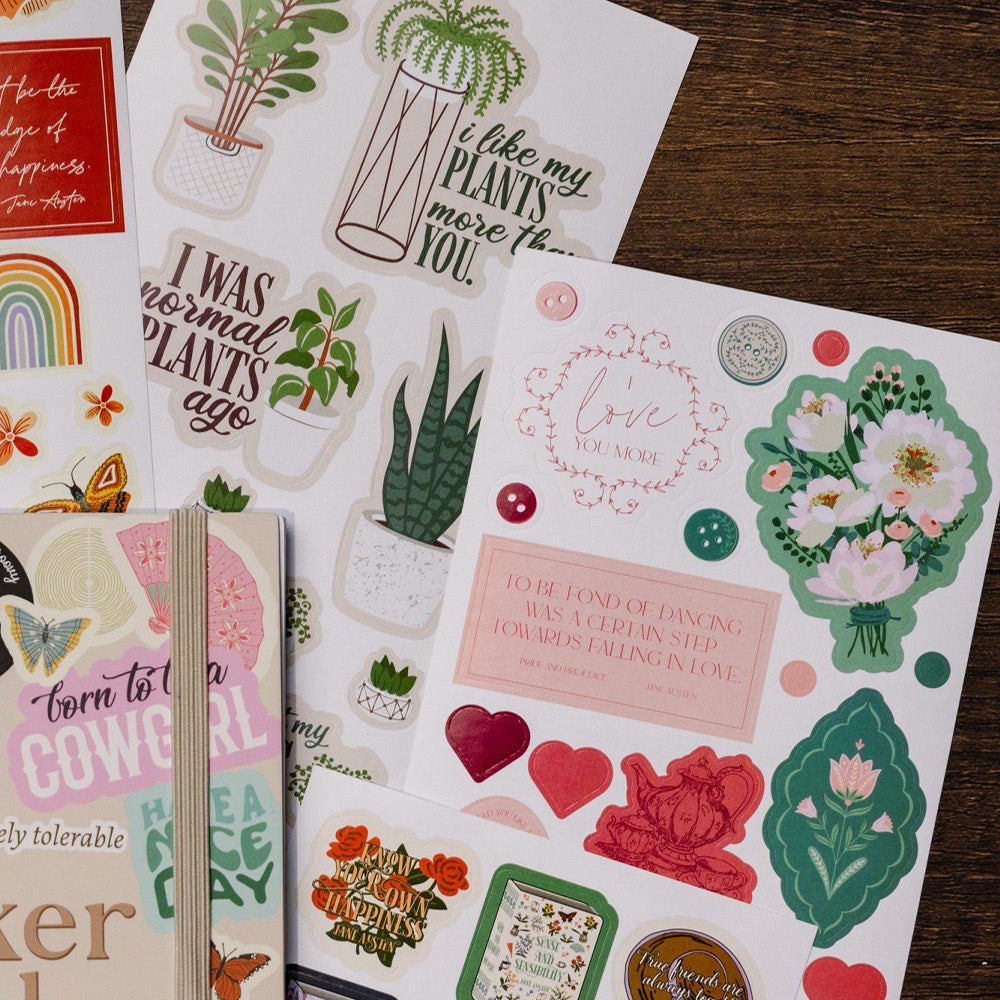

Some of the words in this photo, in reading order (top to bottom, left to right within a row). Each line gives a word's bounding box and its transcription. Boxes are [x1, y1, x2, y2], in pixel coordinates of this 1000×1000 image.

[15, 74, 42, 104] be
[44, 73, 81, 99] the
[47, 112, 68, 143] of
[439, 145, 556, 224] PLANTS
[459, 122, 476, 142] i
[476, 123, 540, 167] like
[542, 158, 592, 197] my
[1, 193, 37, 214] Jane
[39, 189, 87, 212] Austen
[427, 202, 509, 243] more
[167, 242, 196, 289] I
[199, 251, 275, 318] WAS
[414, 222, 480, 285] YOU.
[141, 281, 290, 356] normal
[183, 390, 256, 436] ago
[576, 366, 678, 435] love
[575, 436, 610, 455] YOU
[614, 443, 664, 467] MORE
[505, 572, 531, 592] TO
[536, 578, 561, 599] BE
[566, 584, 622, 611] FOND
[626, 597, 651, 616] OF
[659, 604, 743, 636] DANCING
[526, 600, 564, 623] WAS
[569, 609, 581, 627] A
[586, 613, 665, 643] CERTAIN
[669, 630, 719, 653] STEP
[492, 617, 583, 650] TOWARDS
[587, 638, 662, 668] FALLING
[667, 652, 689, 672] IN
[690, 657, 744, 684] LOVE.
[31, 680, 117, 723] born
[103, 661, 156, 703] to
[20, 685, 268, 798] COWGRL
[291, 718, 330, 749] my
[33, 824, 124, 849] tolerable
[359, 842, 420, 877] KNOW
[315, 880, 427, 943] HAPPINESS
[333, 858, 385, 901] YOUR
[383, 878, 434, 921] OWN
[332, 923, 358, 942] JANE
[359, 933, 399, 954] AUSTEN
[637, 947, 671, 973] True
[668, 958, 720, 989] friends
[722, 982, 746, 997] are
[642, 972, 692, 1000] always
